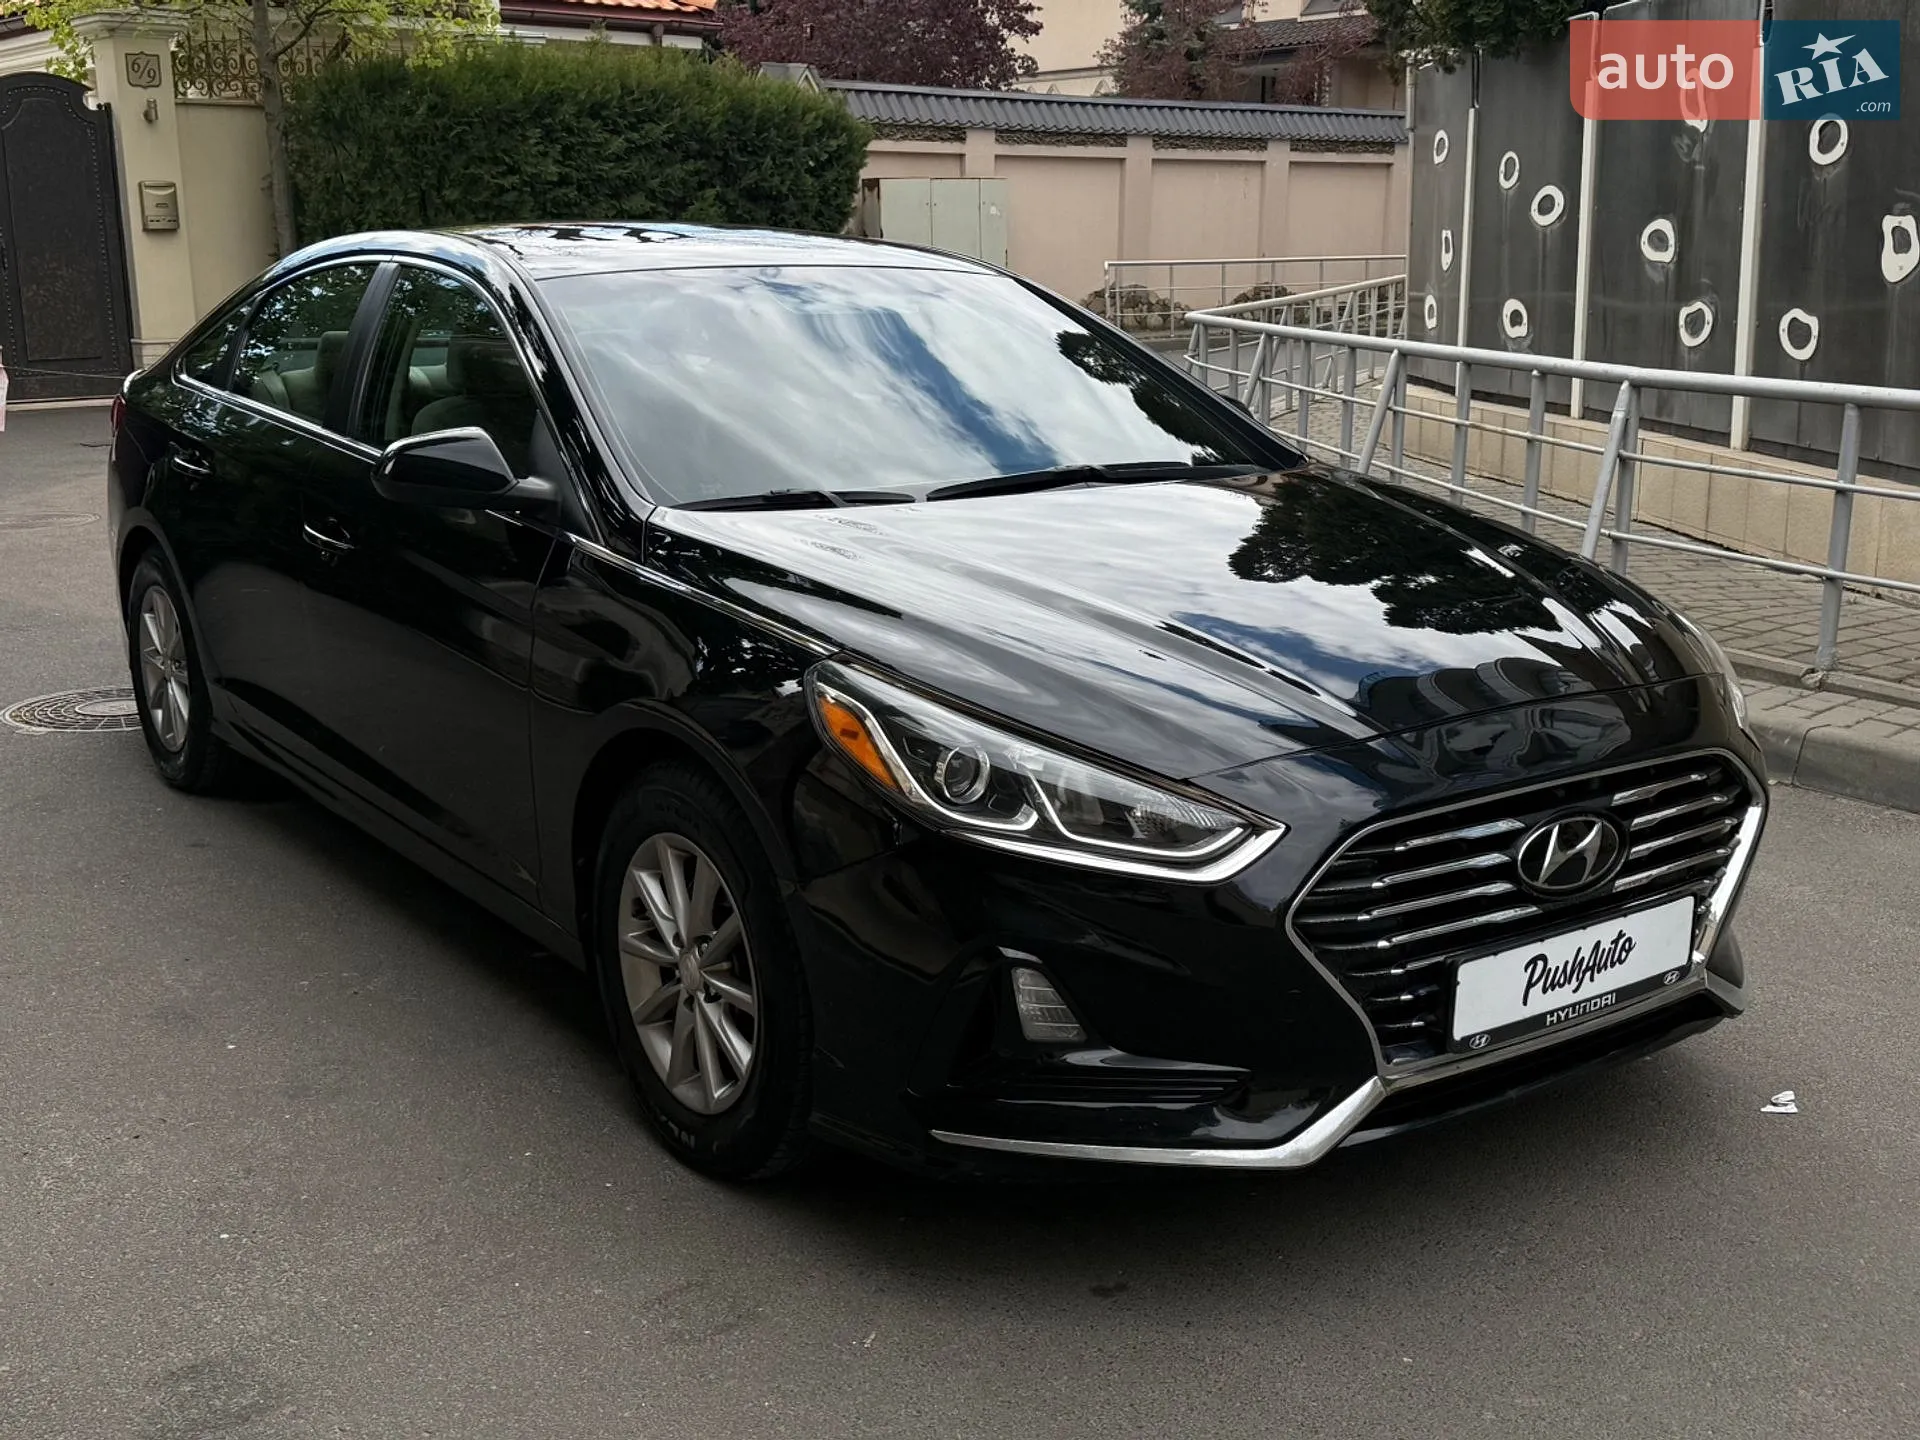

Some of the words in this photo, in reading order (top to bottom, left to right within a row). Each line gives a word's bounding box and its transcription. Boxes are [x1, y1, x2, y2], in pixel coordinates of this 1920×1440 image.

[131, 57, 157, 84] 6/9
[1522, 929, 1636, 1007] PushAuto
[1546, 993, 1617, 1026] HYUNDAI
